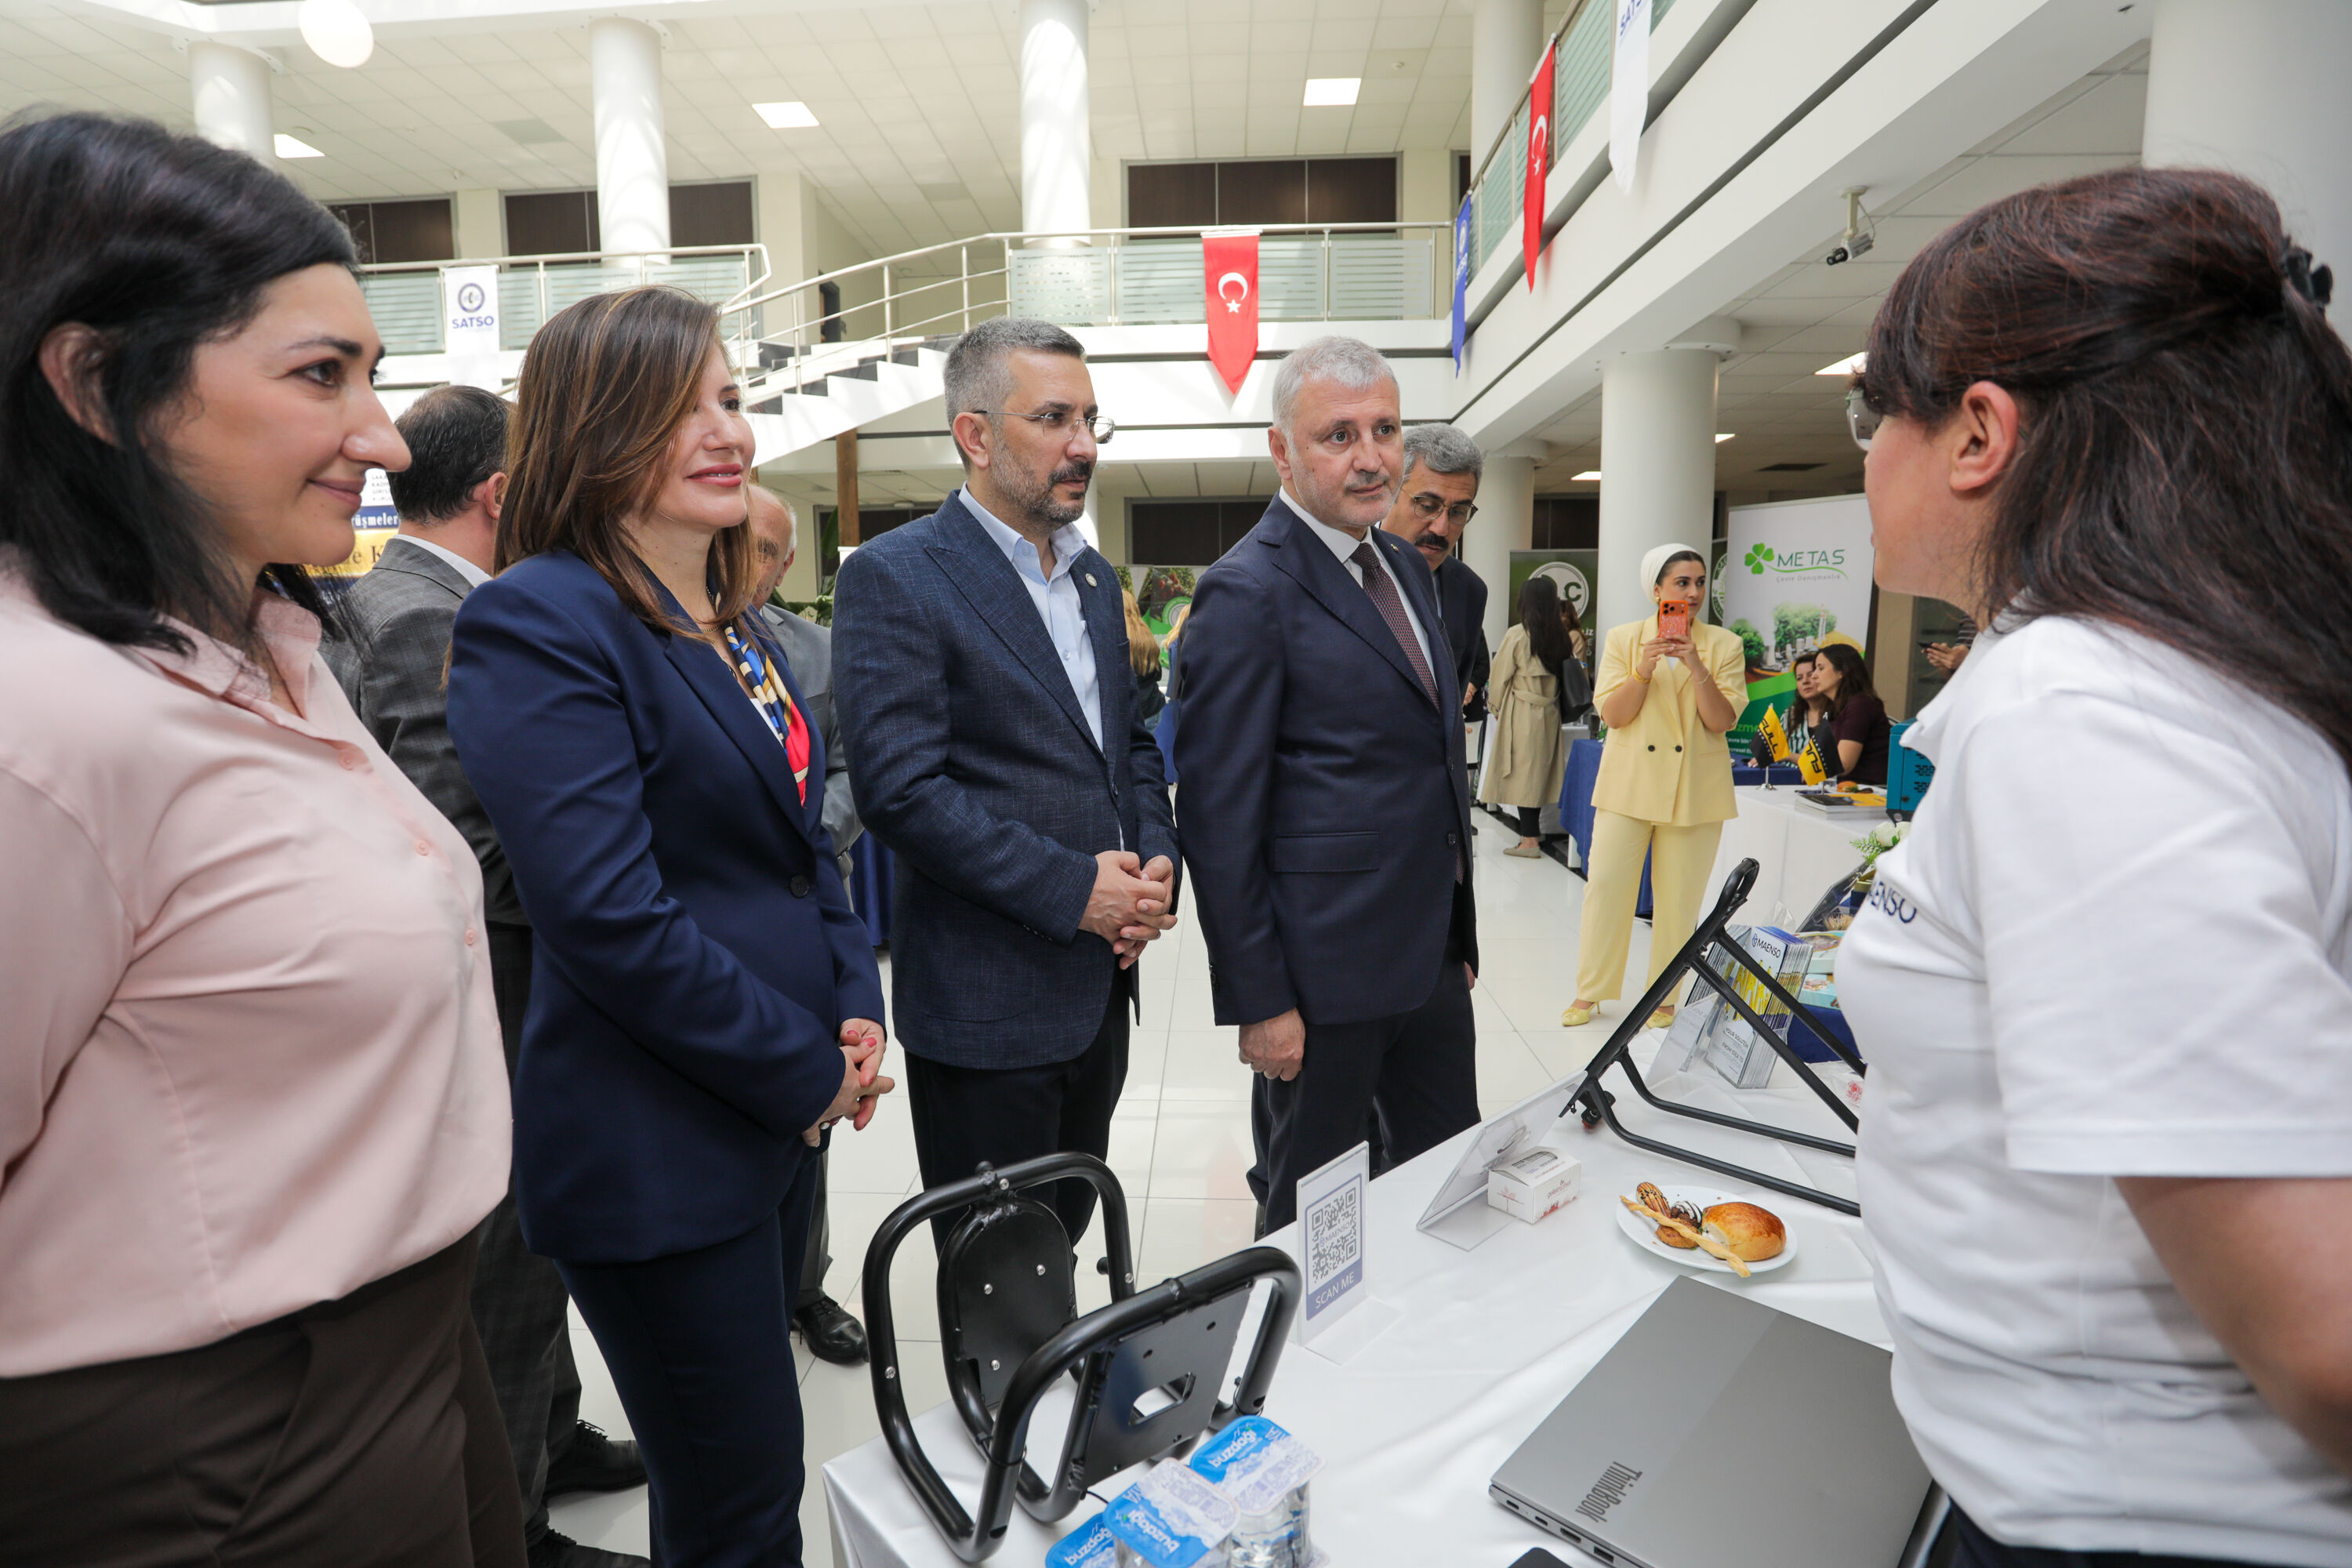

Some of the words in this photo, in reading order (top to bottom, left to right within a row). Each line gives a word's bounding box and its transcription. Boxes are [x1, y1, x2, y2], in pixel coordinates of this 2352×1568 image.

[452, 315, 495, 329] SATSO
[1777, 549, 1845, 568] METAS
[1757, 938, 1781, 959] MAENSO
[1325, 1221, 1351, 1243] MAENSO
[1315, 1283, 1339, 1310] SCAN
[1341, 1271, 1356, 1289] ME
[1575, 1461, 1643, 1523] ThinkBook
